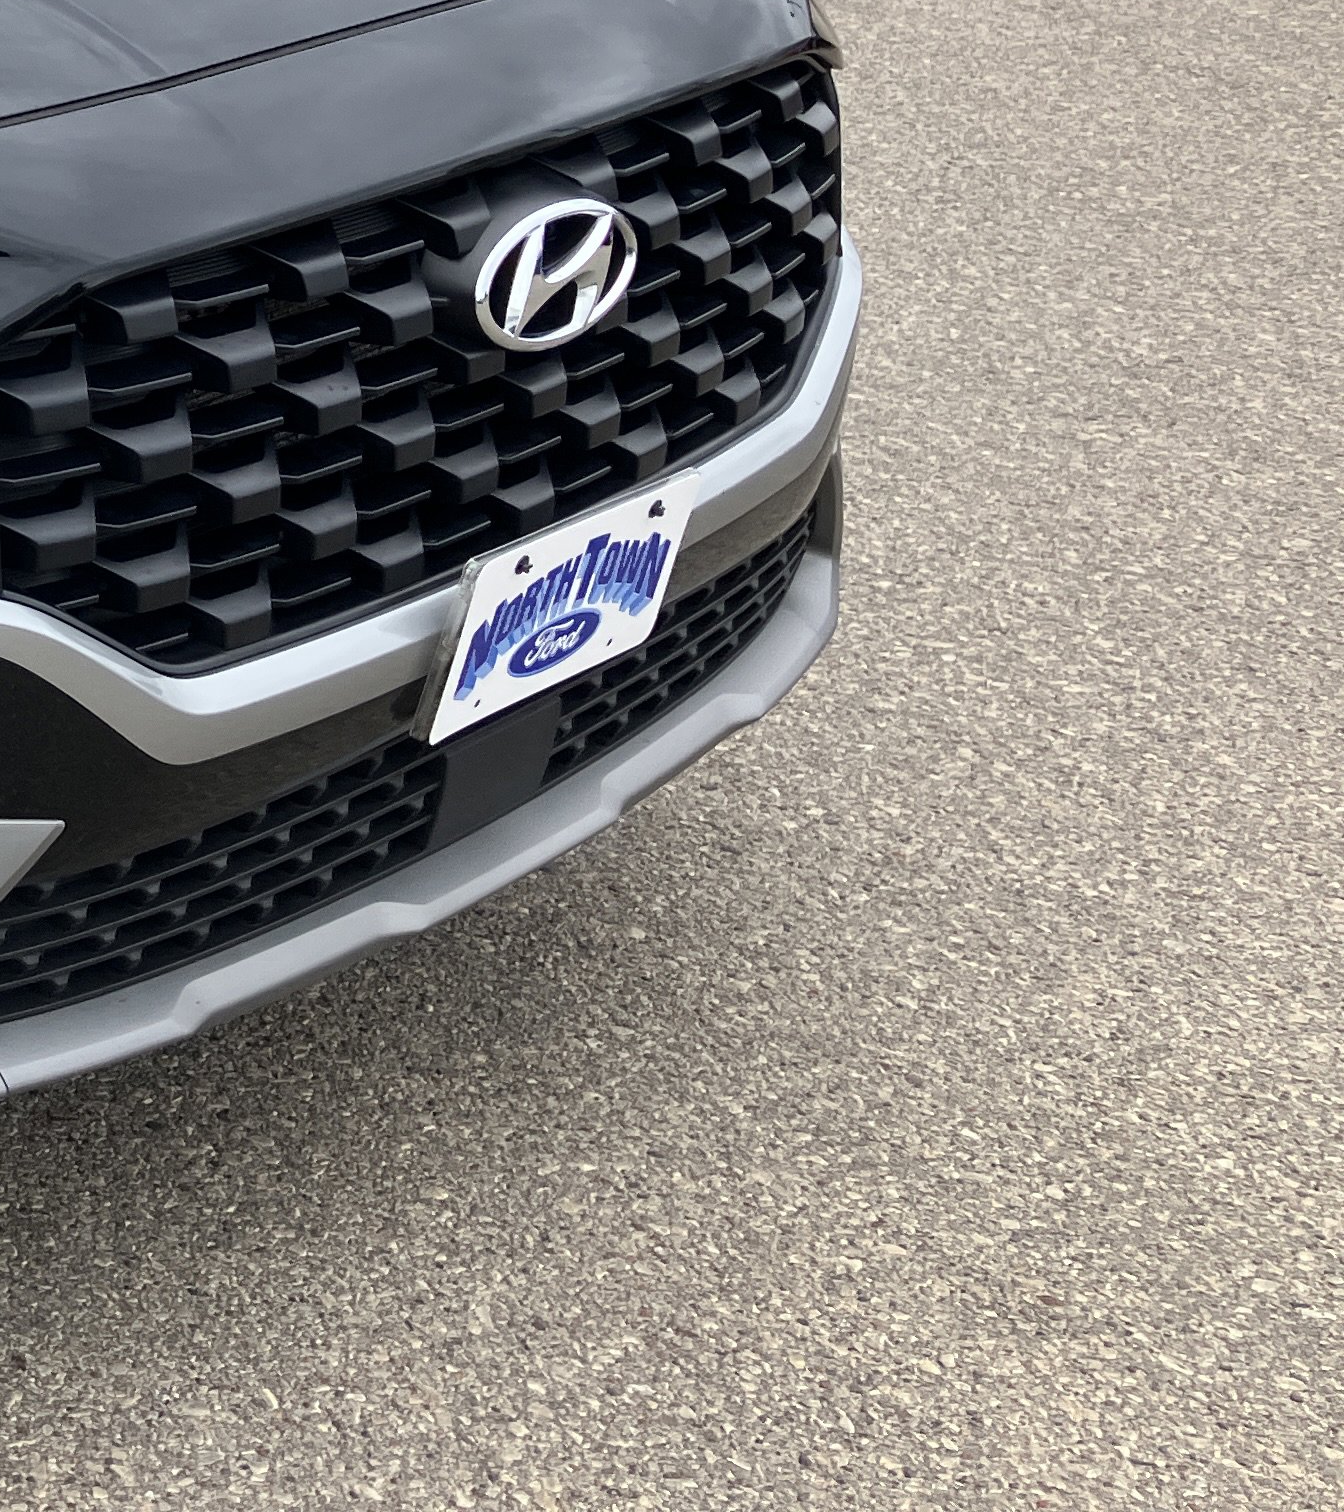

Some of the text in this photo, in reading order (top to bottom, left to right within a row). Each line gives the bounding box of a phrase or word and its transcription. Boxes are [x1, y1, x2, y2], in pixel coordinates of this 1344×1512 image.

[453, 532, 672, 701] NORTH TOWN
[523, 619, 587, 667] Ford
